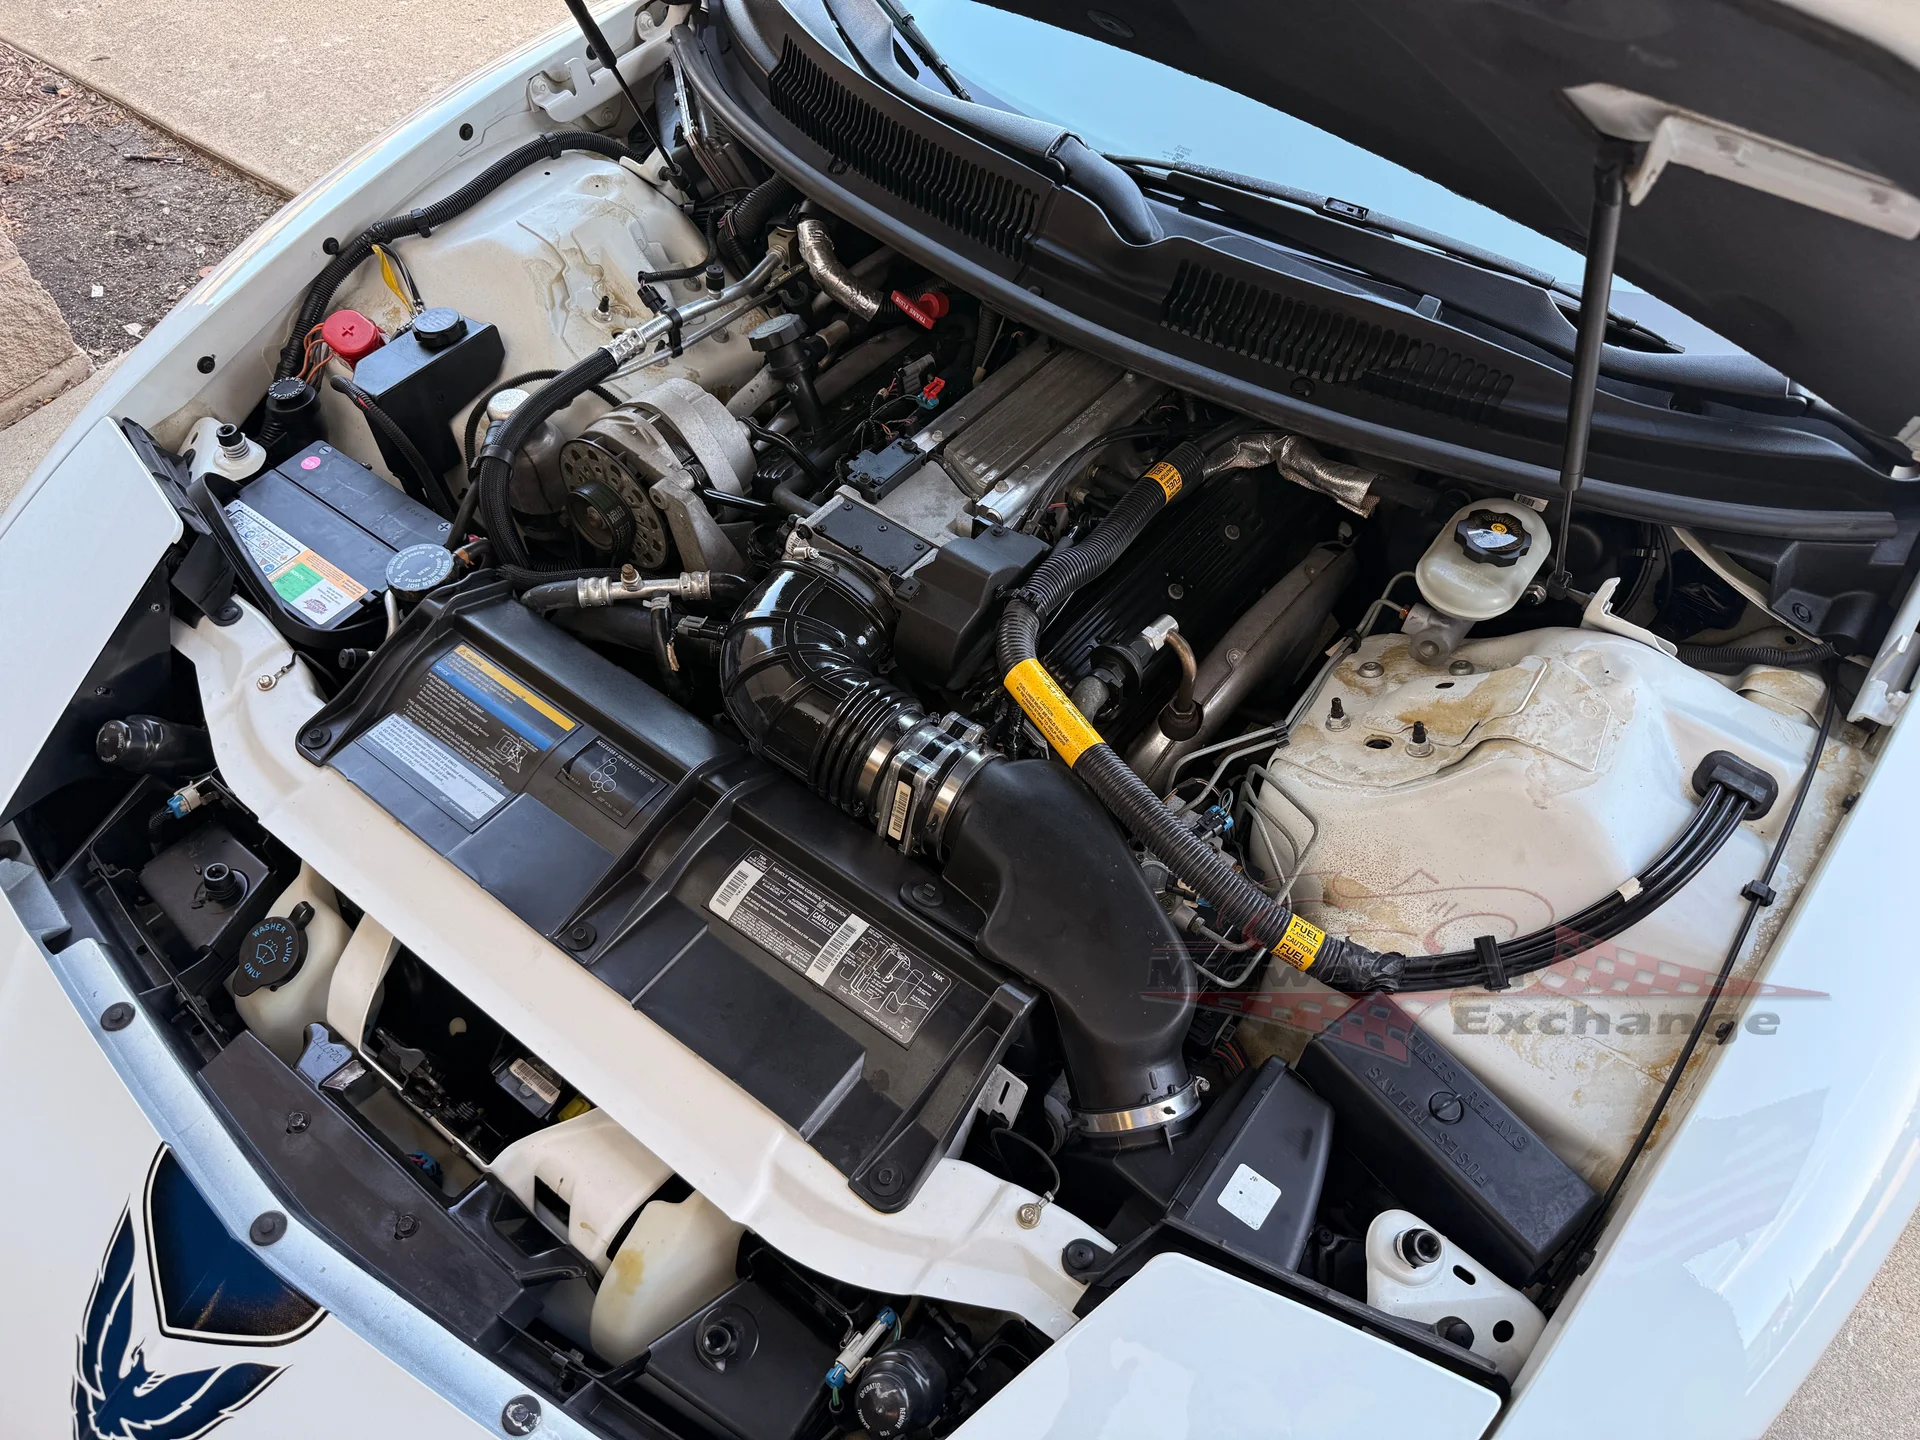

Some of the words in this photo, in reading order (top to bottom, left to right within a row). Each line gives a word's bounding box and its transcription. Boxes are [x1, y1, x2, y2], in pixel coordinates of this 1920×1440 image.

[908, 307, 925, 323] TRANS
[1166, 476, 1182, 490] FUEL
[438, 559, 449, 575] NEVER
[422, 575, 439, 586] OPEN
[434, 664, 449, 676] NOTICE
[1039, 699, 1054, 717] CAUTION
[1033, 700, 1043, 712] MUST
[1045, 715, 1056, 727] HELD
[1057, 729, 1069, 742] PLACE
[595, 739, 618, 757] ACCESSORY
[616, 754, 629, 764] DRIVE
[628, 762, 639, 771] BELT
[637, 769, 656, 783] ROUTING
[771, 866, 788, 879] VEHICLE
[787, 876, 803, 889] EMISSION
[802, 886, 821, 901] CONTROL
[820, 898, 847, 917] INFORMATION
[811, 911, 838, 932] CATALYST
[1293, 921, 1320, 942] FUEL
[253, 923, 286, 937] WASHER
[282, 935, 292, 963] FLUID
[1279, 942, 1307, 964] FUEL
[1285, 934, 1313, 955] CAUTION
[1275, 948, 1302, 967] FLAMMABLE
[244, 962, 261, 978] ONLY
[930, 970, 945, 982] TMK
[1363, 1063, 1429, 1125] RELAYS
[1402, 1032, 1459, 1086] FUSES
[1463, 1089, 1529, 1151] RELAYS
[1431, 1128, 1492, 1187] FUSES
[860, 1382, 882, 1399] OPERATIO
